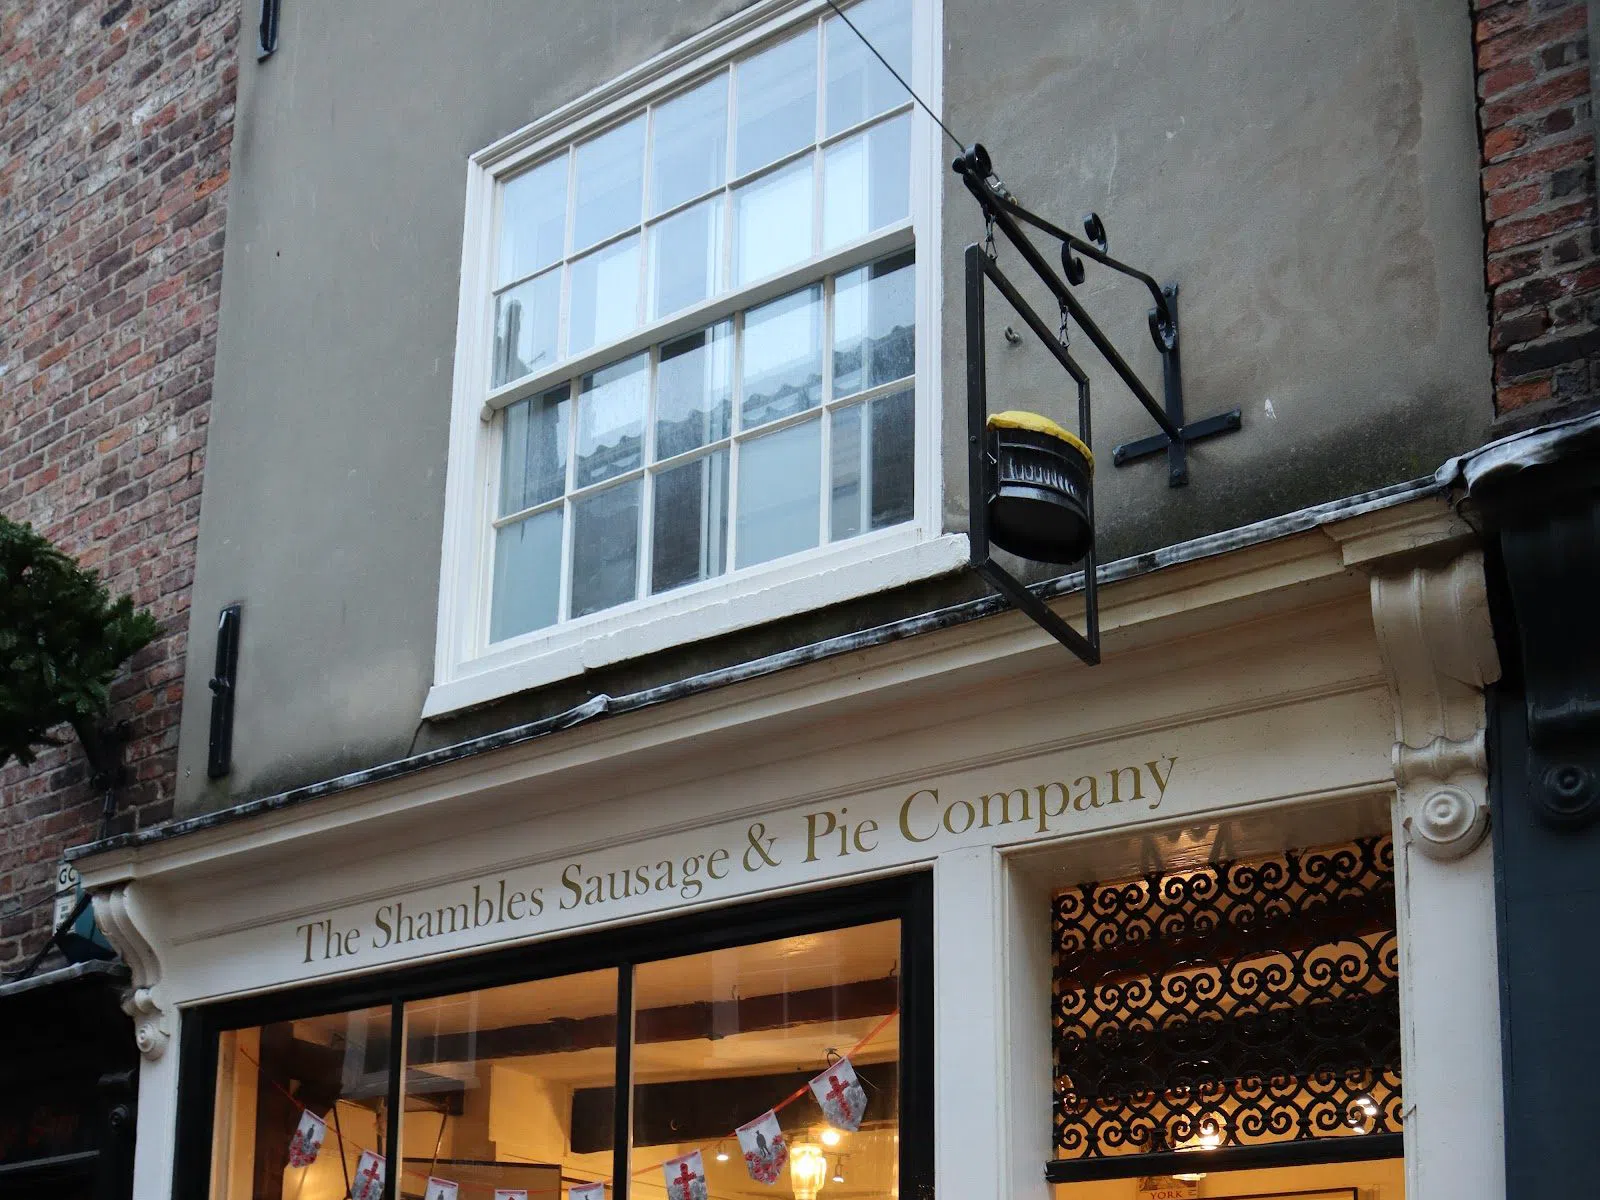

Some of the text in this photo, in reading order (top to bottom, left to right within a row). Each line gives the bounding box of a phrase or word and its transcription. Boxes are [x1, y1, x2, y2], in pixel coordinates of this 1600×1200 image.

[296, 756, 1179, 964] The Shambles Sausage & Pie Company
[1150, 1190, 1184, 1200] YORK
